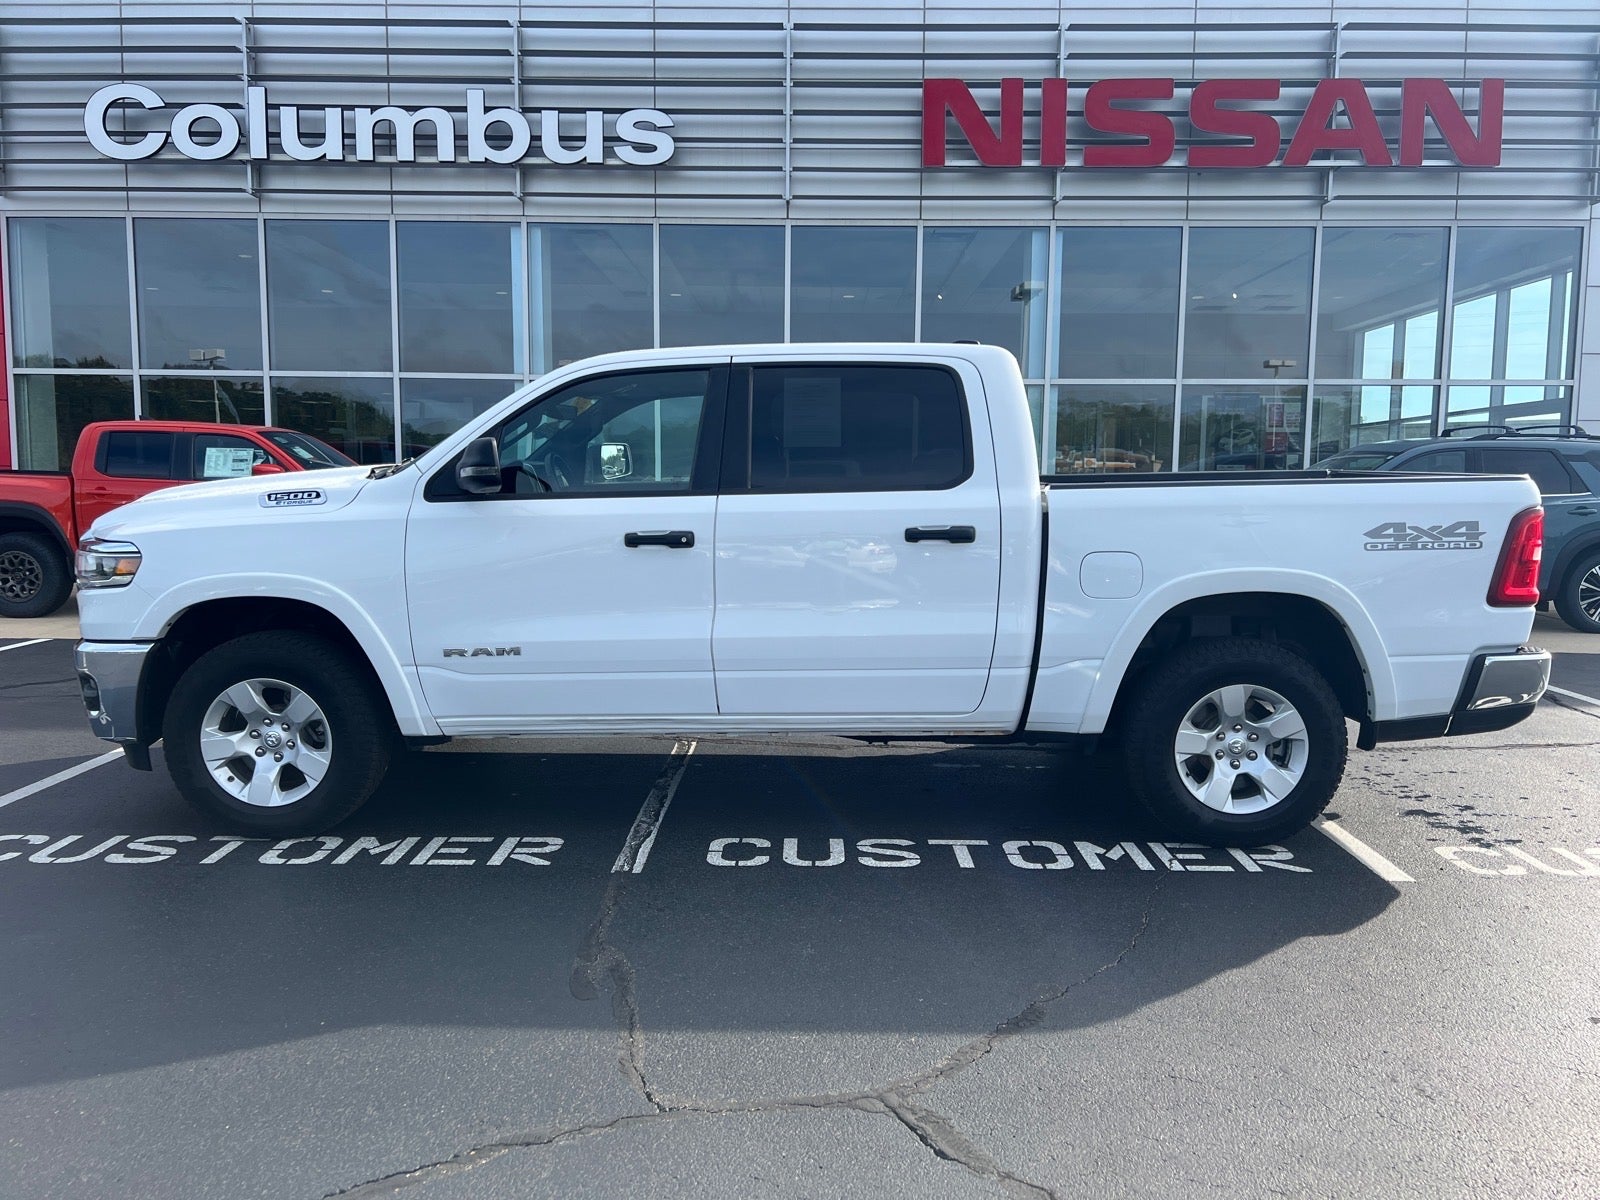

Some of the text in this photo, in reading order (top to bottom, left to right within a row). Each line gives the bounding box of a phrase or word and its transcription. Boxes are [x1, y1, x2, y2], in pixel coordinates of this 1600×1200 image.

[83, 83, 675, 165] Columbus
[922, 78, 1504, 168] NISSAN
[269, 491, 318, 501] 1500
[1366, 541, 1481, 550] OFF ROAD
[443, 646, 521, 657] RAM
[706, 837, 1313, 873] CUSTOMER
[1433, 846, 1600, 876] CU
